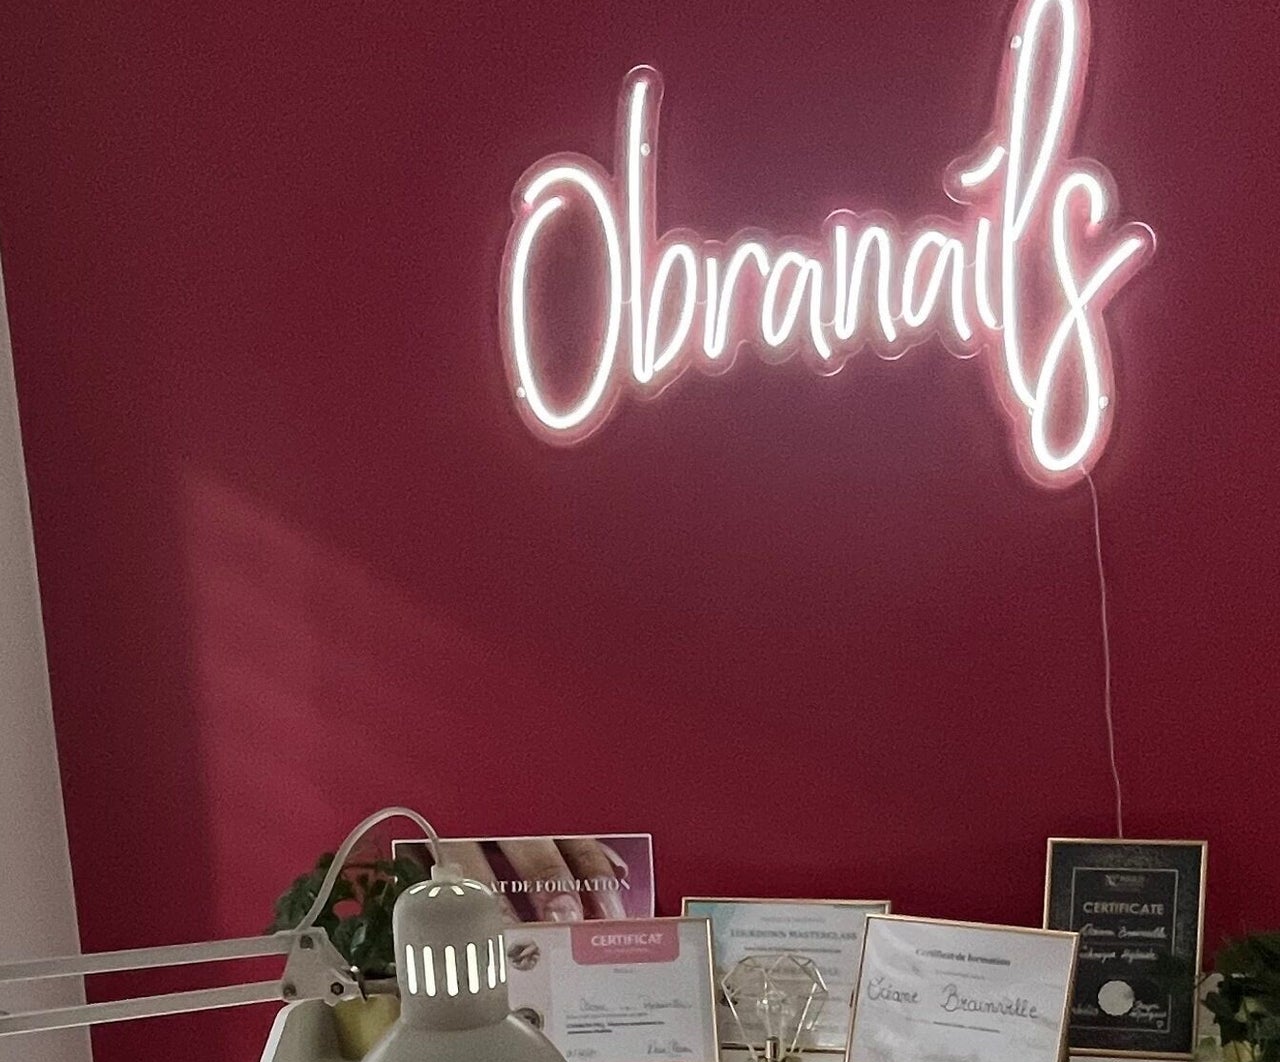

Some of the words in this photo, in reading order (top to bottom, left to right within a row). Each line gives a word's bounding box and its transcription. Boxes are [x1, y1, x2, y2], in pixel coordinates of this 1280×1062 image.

[511, 0, 1145, 472] Obranails
[512, 880, 533, 893] DE
[535, 877, 631, 893] FORMATION
[1082, 902, 1164, 916] CERTIFICATE
[590, 933, 664, 947] CERTIFICAT
